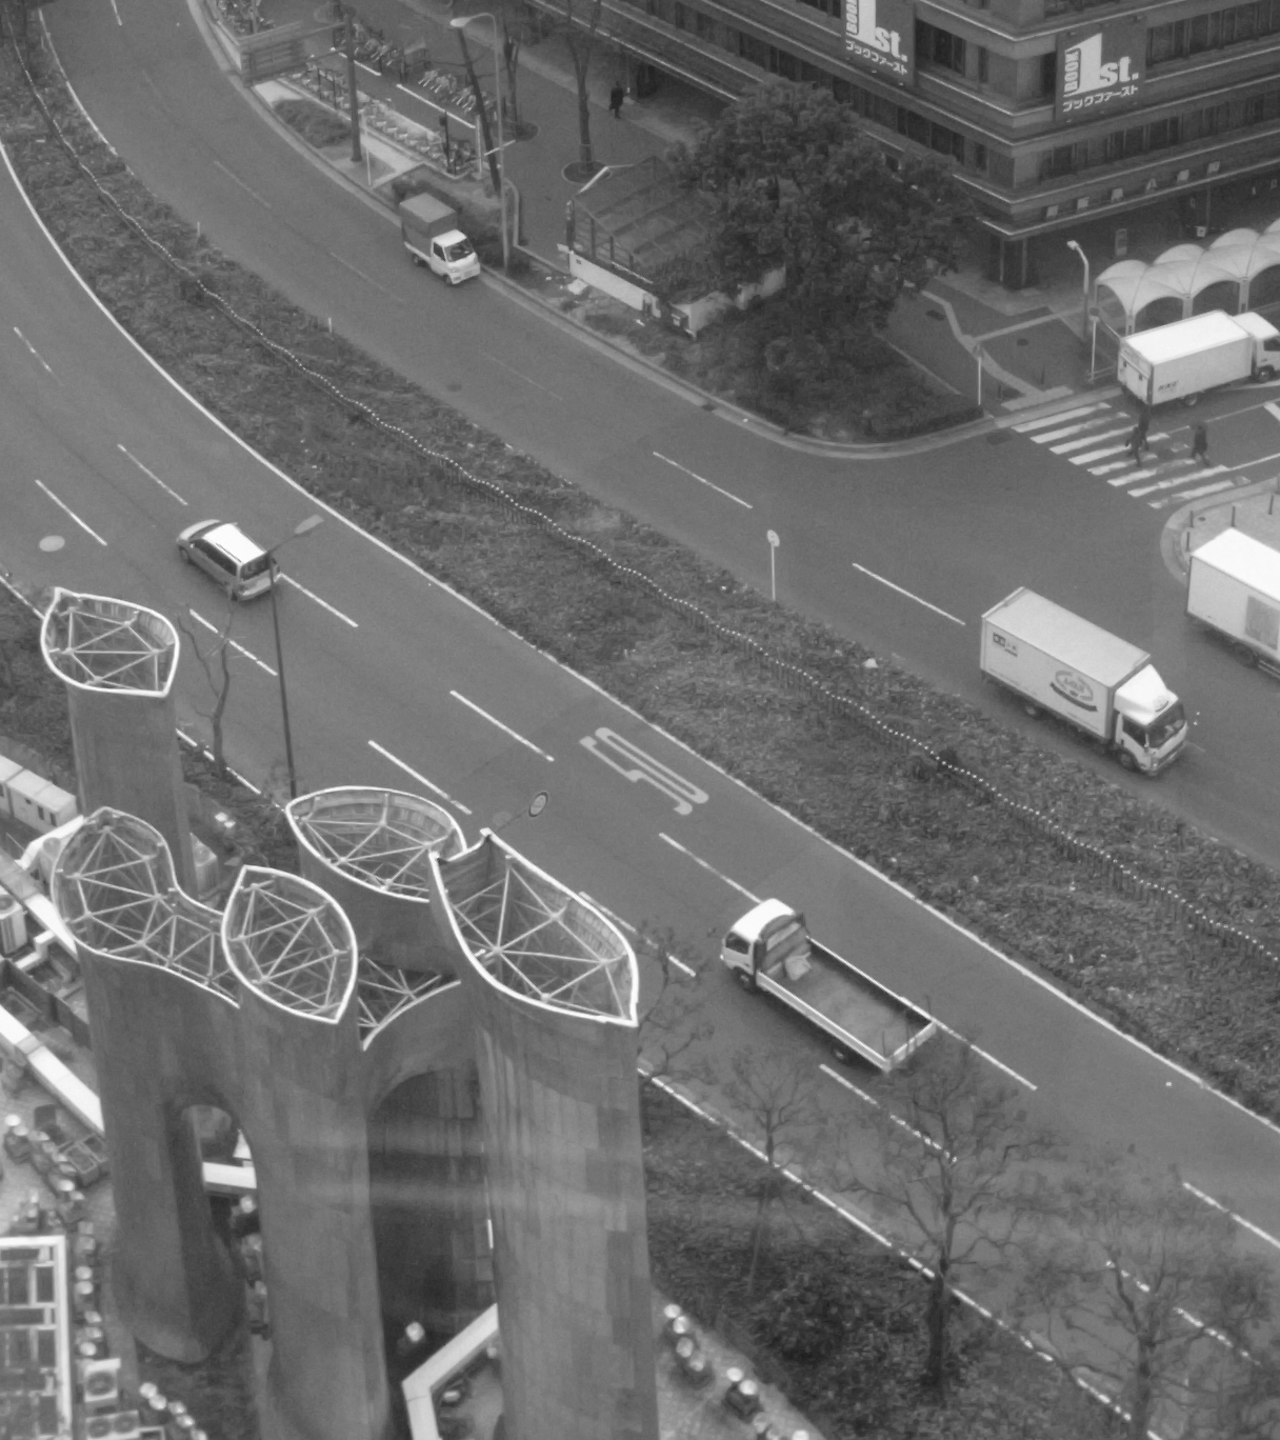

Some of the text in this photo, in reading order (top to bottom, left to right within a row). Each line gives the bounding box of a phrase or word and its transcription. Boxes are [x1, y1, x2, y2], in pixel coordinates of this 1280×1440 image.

[845, 40, 908, 75] ブックファースト
[1064, 50, 1080, 93] BOOK
[1063, 84, 1139, 113] ブックファースト
[579, 726, 709, 816] 50
